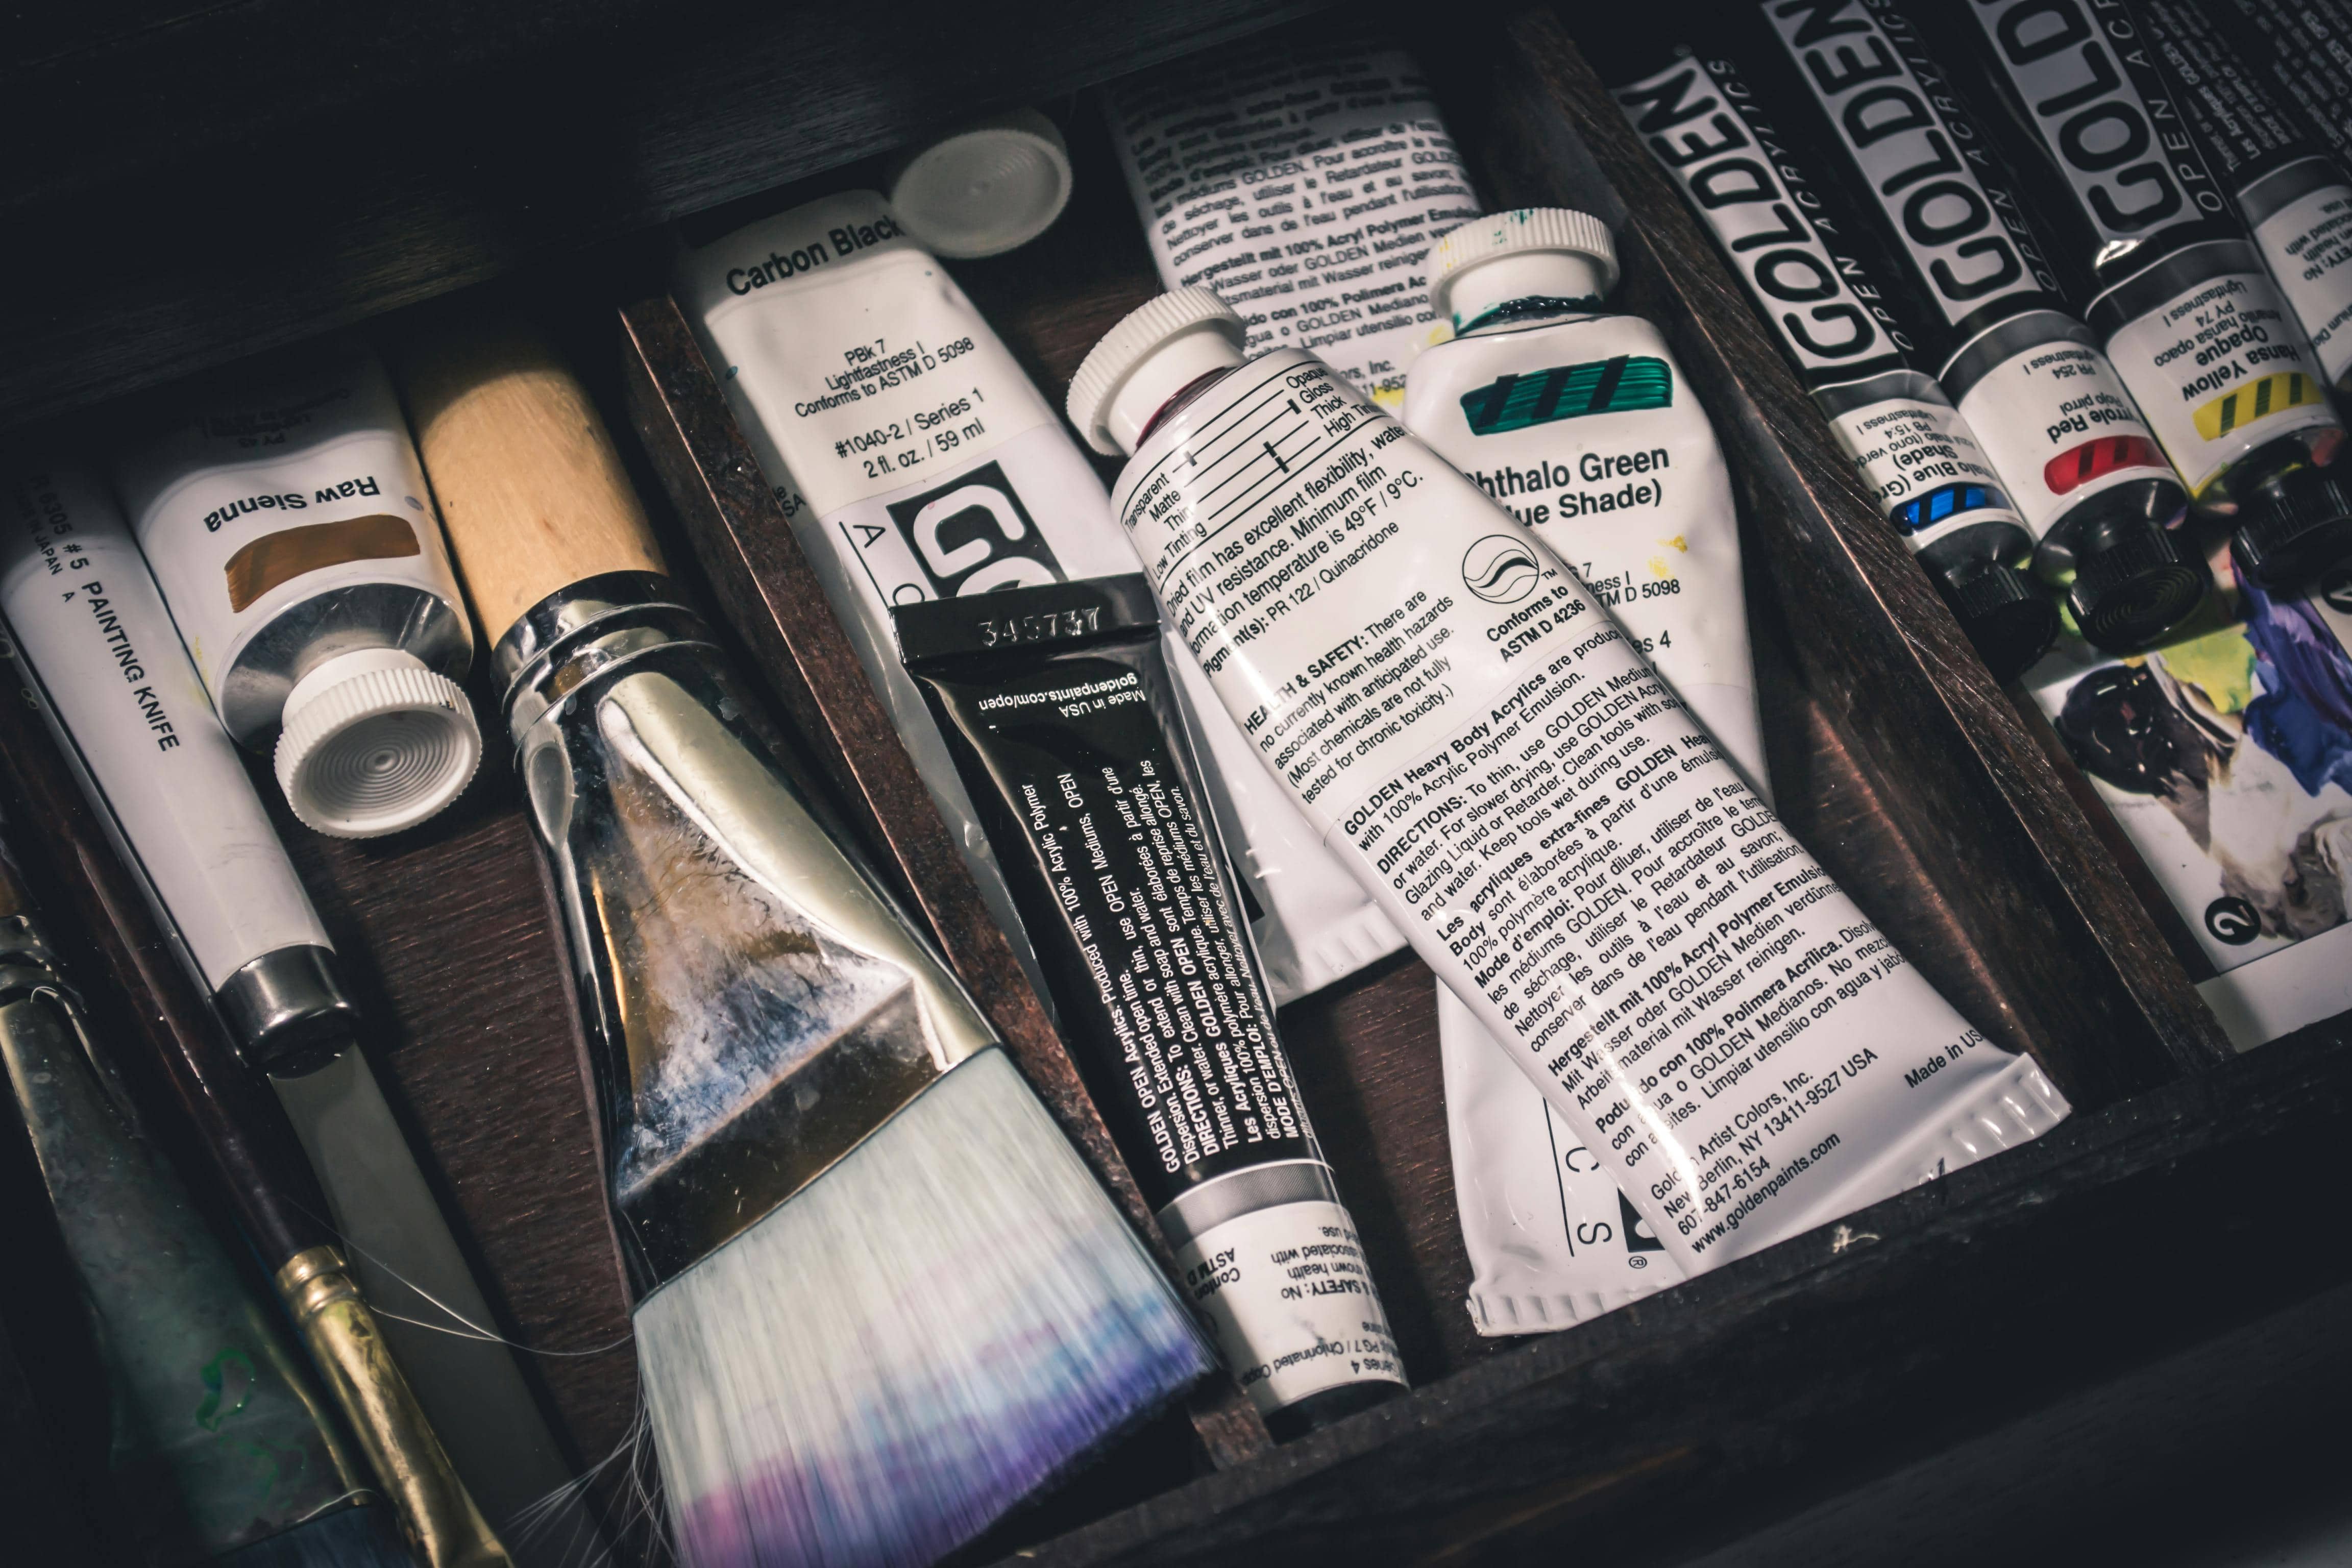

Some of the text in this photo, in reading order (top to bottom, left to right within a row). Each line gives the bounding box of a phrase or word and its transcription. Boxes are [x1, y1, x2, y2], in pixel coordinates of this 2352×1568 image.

[1986, 0, 2184, 236] GOLD
[1775, 2, 2023, 302] GOLDEN
[2148, 100, 2224, 207] OPEN
[1618, 68, 1875, 361] GOLDEN
[1988, 189, 2057, 289] OPEN
[725, 214, 904, 296] Carbon Black
[1835, 252, 1913, 350] OPEN
[2195, 310, 2215, 328] 74
[2215, 299, 2236, 319] PY
[843, 338, 885, 366] PBk 7
[2153, 338, 2195, 367] opaco
[2194, 315, 2239, 345] hansa
[2195, 323, 2269, 366] Opaque
[794, 336, 974, 418] Conforms to ASTM D 5098
[824, 340, 925, 390] Lightfastness I
[1285, 363, 1328, 388] Opaque
[1298, 382, 1334, 404] Gloss
[2182, 344, 2301, 401] Hansa Yellow
[835, 387, 984, 458] #1040-2 / Series 1
[1310, 395, 1347, 419] Thick
[2046, 413, 2089, 444] Red
[863, 416, 985, 478] 2 fl. oz. / 59 ml
[1579, 448, 1670, 482] Green
[1892, 444, 1958, 471] Shade)
[1912, 461, 1957, 482] Blue
[203, 475, 380, 532] Raw Sienna
[1124, 472, 1170, 532] Transparent
[1148, 490, 1181, 522] Matte
[1558, 478, 1662, 519] Shade)
[62, 543, 90, 570] # 5
[1152, 522, 1207, 580] Low Tinting
[1179, 465, 1387, 640] and UV resistance. Minimum film
[1185, 470, 1423, 659] formation temperature is 49°F / 9°C.
[1582, 561, 1592, 578] 7
[1202, 522, 1399, 679] Pigment(s): PR 122 / Quinacridone
[1486, 596, 1553, 642] Conforms
[1550, 585, 1569, 599] to
[1624, 586, 1637, 602] D
[1641, 578, 1681, 599] 5098
[1294, 674, 1310, 688] &
[1307, 634, 1369, 678] SAFETY:
[1364, 608, 1405, 639] There
[1404, 591, 1427, 611] are
[1499, 626, 1542, 663] ASTM
[1537, 619, 1553, 634] D
[1553, 598, 1586, 624] 4236
[1659, 629, 1672, 648] 4
[81, 580, 180, 752] PAINTING KNIFE
[978, 672, 1138, 710] goldenpaints.com/open
[1259, 596, 1453, 753] no currently known health hazards
[1058, 689, 1146, 718] Made in USA
[1274, 627, 1454, 770] associated with anticipated use.
[1358, 672, 1585, 851] with 100% Acrylic Polymer Emulsion.
[2214, 905, 2254, 937] 2
[1057, 772, 1220, 1156] DIRECTIONS: To extend or thin, use OPEN Mediums, OPEN
[1119, 969, 1200, 1165] Dispersion. Extended open time.
[1698, 1124, 1737, 1161] Artist
[1734, 1093, 1787, 1130] Colors,
[1782, 1072, 1814, 1094] Inc.
[1698, 1155, 1743, 1192] Berlin,
[1737, 1130, 1762, 1156] NY
[1763, 1070, 1841, 1136] 13411-9527
[1840, 1047, 1878, 1077] USA
[1691, 1133, 1841, 1253] www.goldenpaints.com
